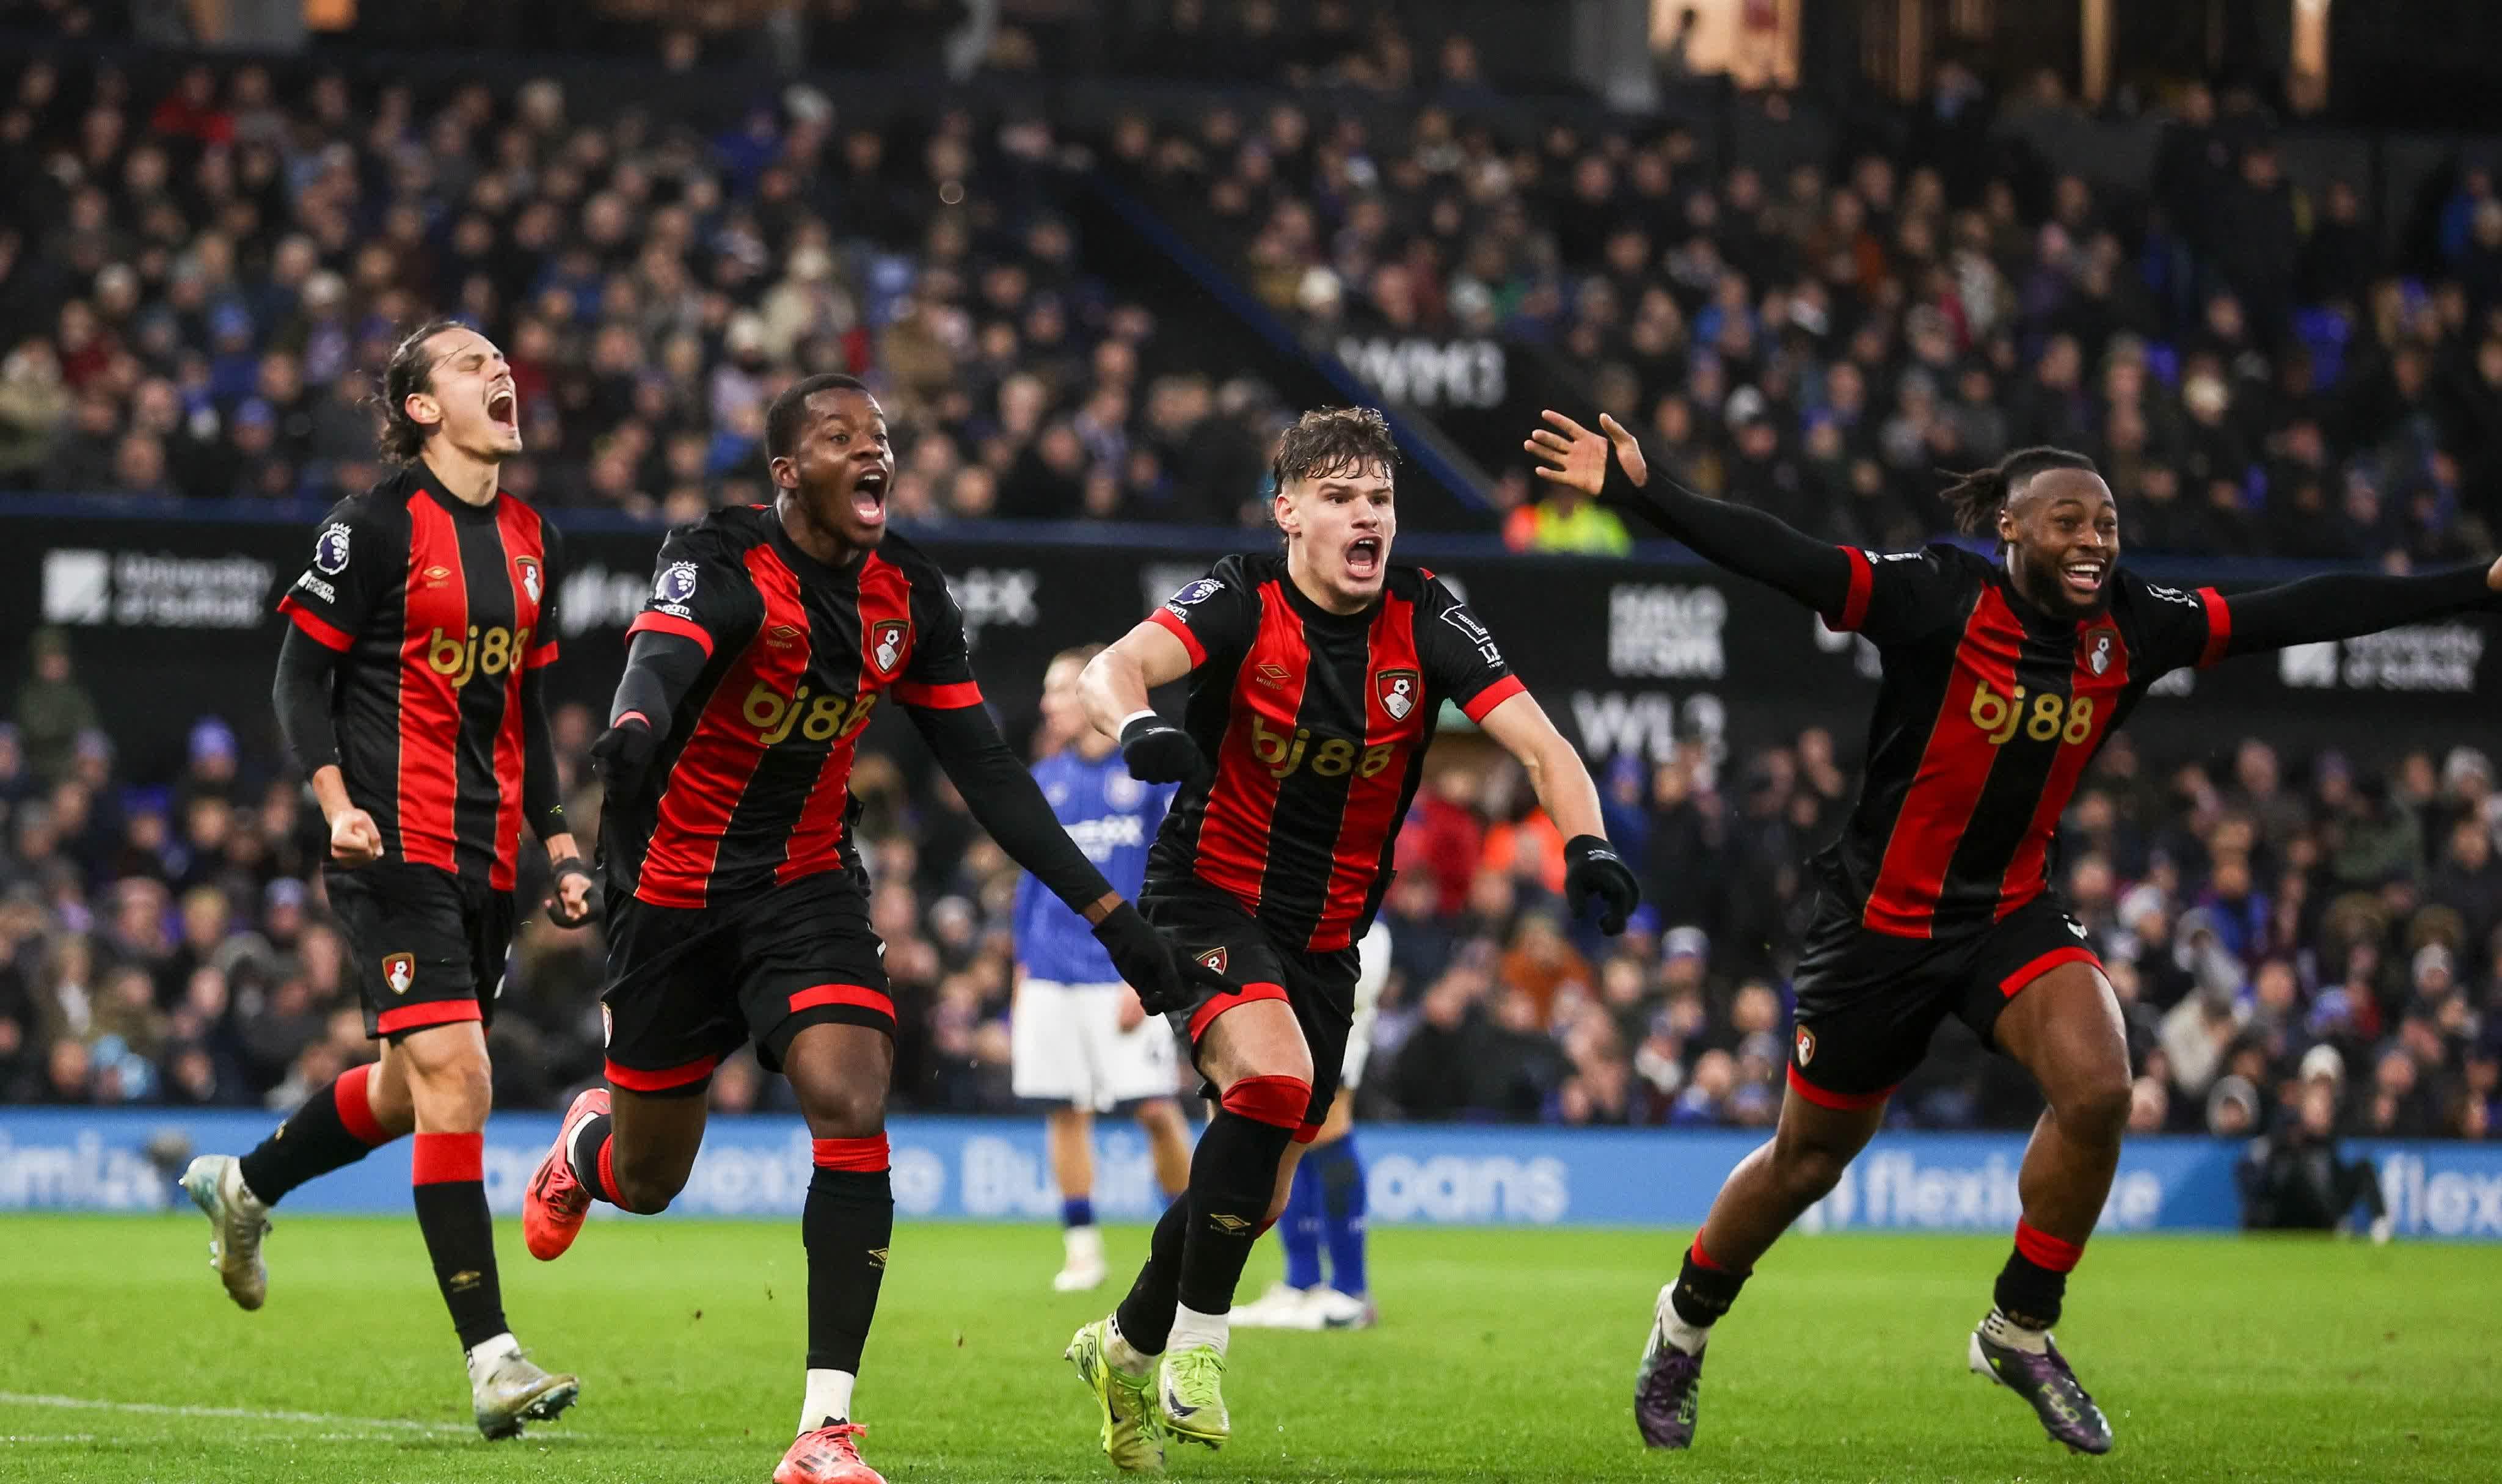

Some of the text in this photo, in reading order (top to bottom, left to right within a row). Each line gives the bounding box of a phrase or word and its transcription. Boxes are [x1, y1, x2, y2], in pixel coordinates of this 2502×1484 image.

[428, 625, 529, 688] bj88
[743, 681, 877, 744] bj88
[1970, 679, 2093, 745] bj88
[1252, 713, 1395, 779] bj88
